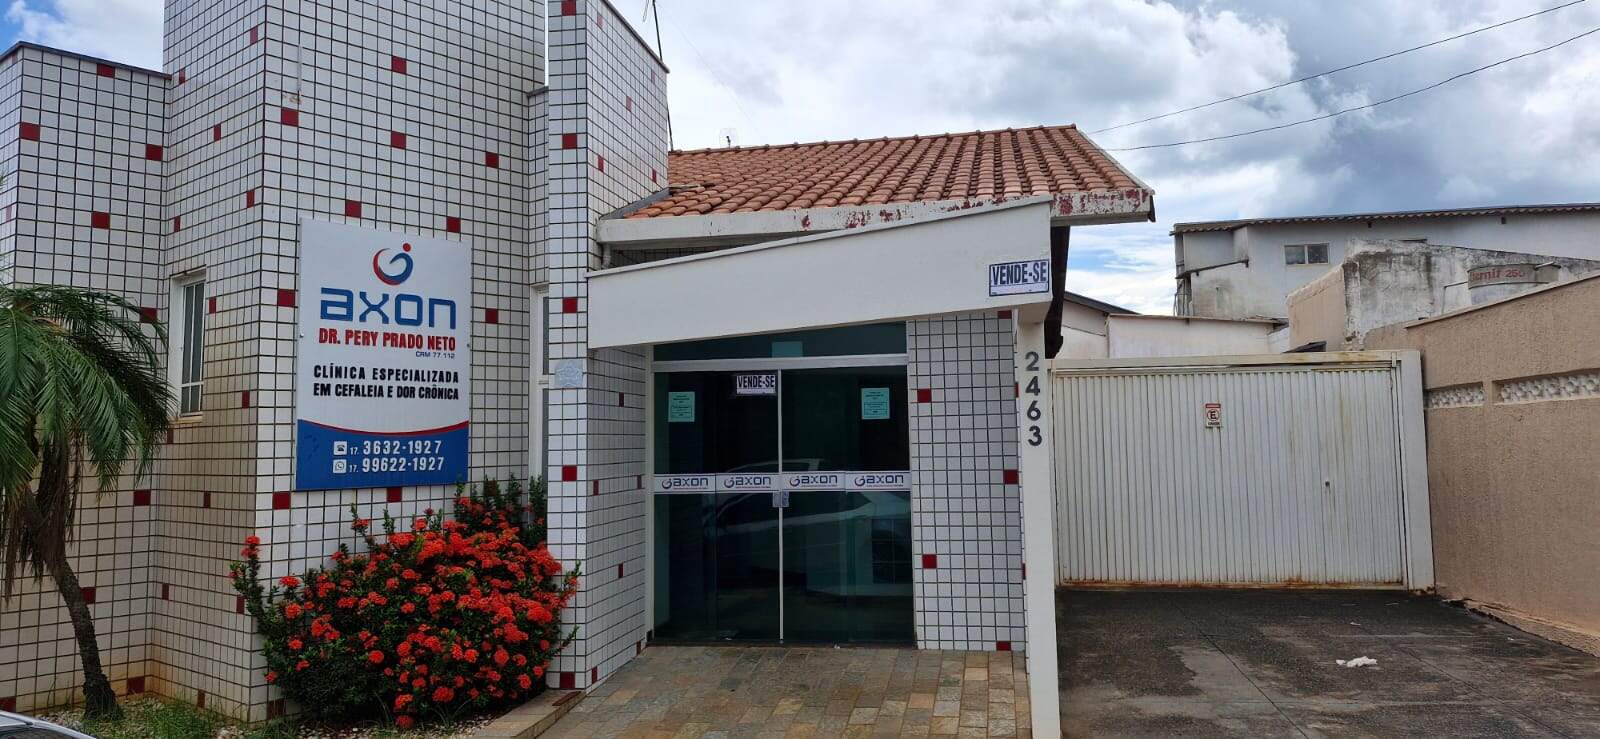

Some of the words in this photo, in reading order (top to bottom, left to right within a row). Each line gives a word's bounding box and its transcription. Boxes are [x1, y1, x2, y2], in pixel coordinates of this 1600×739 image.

[992, 261, 1047, 285] VENDE-SE
[320, 287, 456, 330] axon
[319, 327, 341, 345] DR.
[345, 329, 379, 347] PERY
[383, 331, 424, 350] PRADO
[427, 335, 456, 352] NETO
[415, 350, 431, 358] CRM
[313, 362, 366, 381] CLÍNICA
[372, 367, 459, 384] ESPECIALIZADA
[737, 375, 775, 388] VENDE-SE
[313, 383, 332, 397] EM
[334, 383, 384, 399] CEFALEIA
[387, 384, 393, 399] E
[396, 385, 416, 400] DOR
[418, 384, 459, 401] CRÔNICA
[1024, 351, 1043, 447] 2463
[362, 439, 442, 455] 3632-1927
[361, 456, 445, 474] 99622-1927
[673, 477, 709, 487] axon
[735, 476, 772, 486] axon
[801, 474, 838, 484] axon
[866, 474, 904, 484] axon
